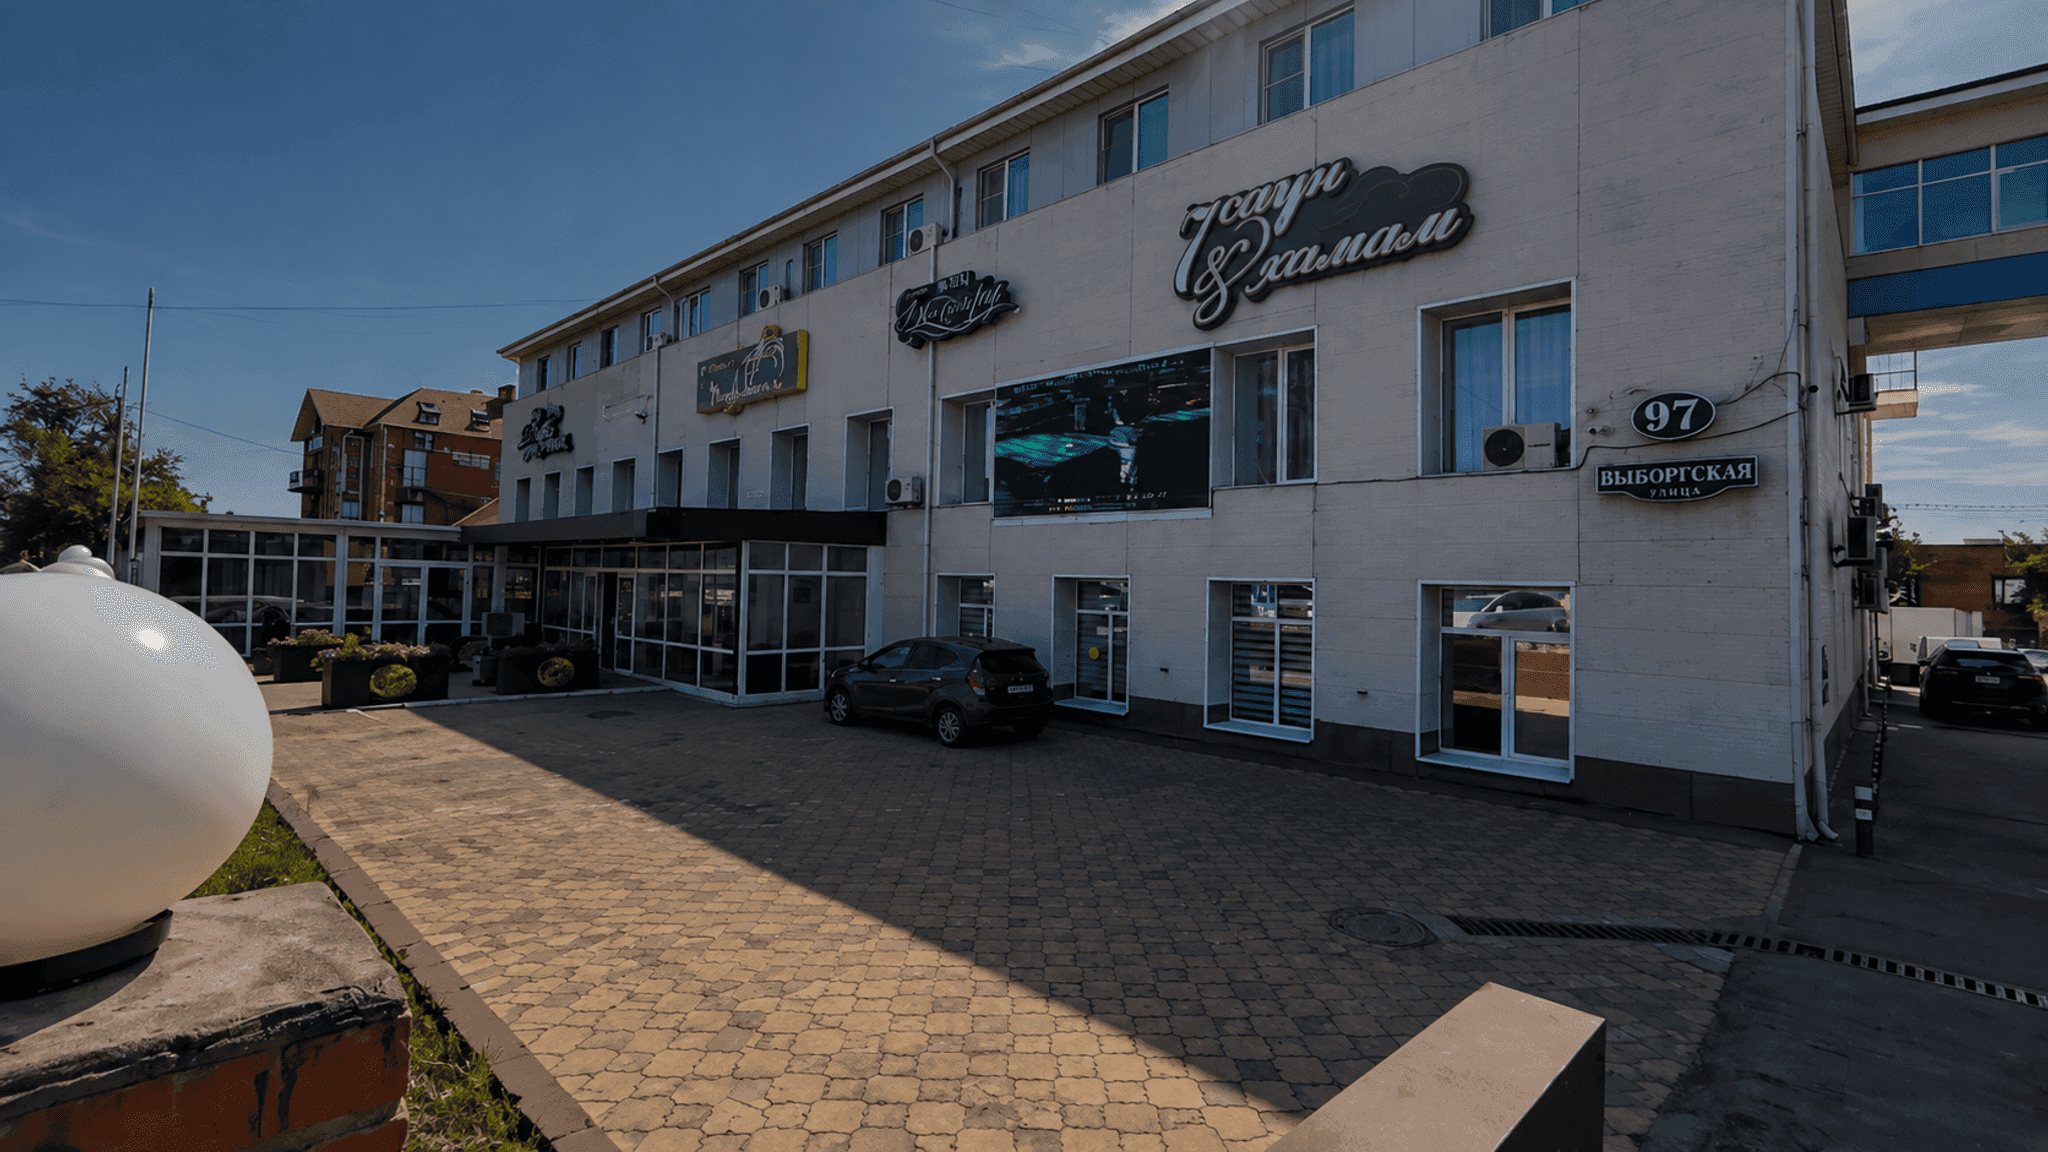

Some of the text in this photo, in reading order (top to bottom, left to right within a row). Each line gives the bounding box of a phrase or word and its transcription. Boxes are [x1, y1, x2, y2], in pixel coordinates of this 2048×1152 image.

[1175, 160, 1347, 293] 7 саун
[1194, 208, 1463, 324] & хамам
[1645, 398, 1699, 431] 97
[1600, 463, 1752, 486] ВЫБОРГСКАЯ
